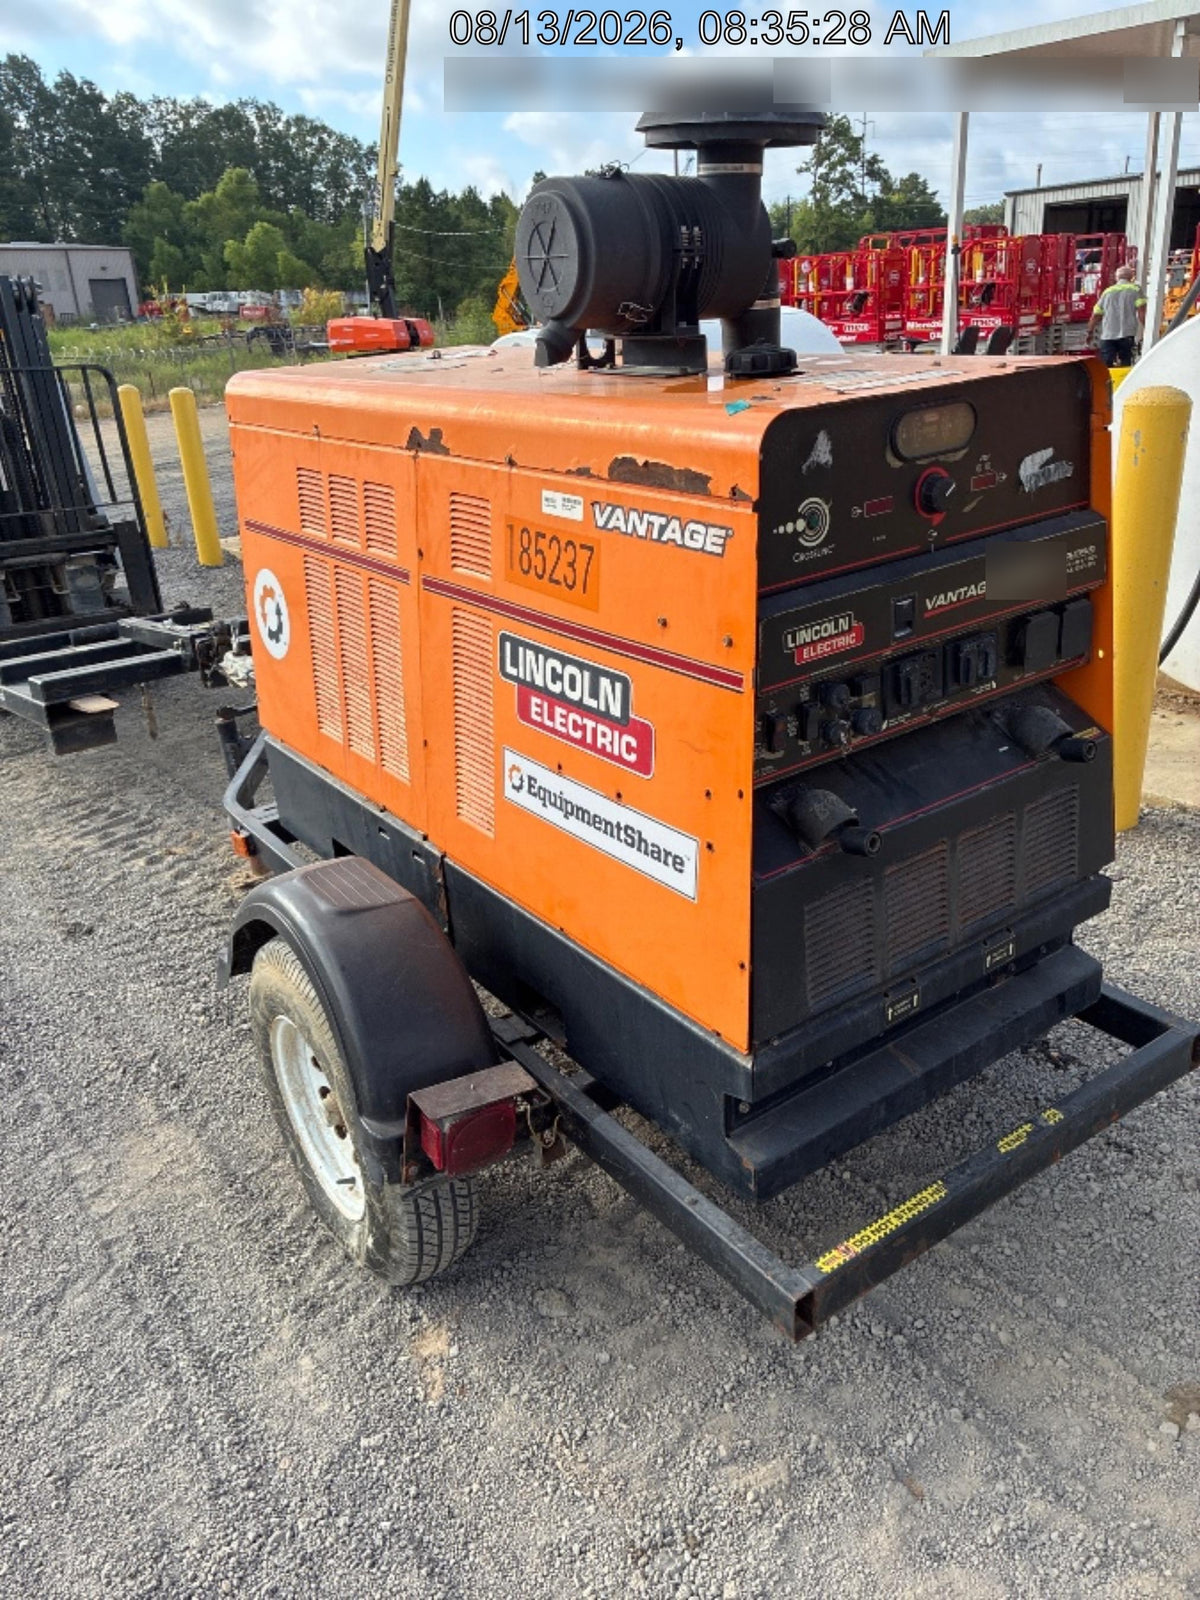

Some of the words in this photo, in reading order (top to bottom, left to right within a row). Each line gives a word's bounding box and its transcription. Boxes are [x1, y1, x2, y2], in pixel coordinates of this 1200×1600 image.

[592, 502, 727, 558] VANTAGE
[507, 522, 595, 595] 185237
[925, 581, 986, 610] VANTAG
[787, 618, 849, 648] LINCOLN
[802, 633, 857, 659] ELECTRIC
[504, 640, 623, 717] LINCOLN
[530, 696, 638, 763] ELECTRIC
[526, 775, 687, 875] EquipmentShare
[852, 1235, 872, 1248] DO
[871, 1219, 895, 1237] NOT
[893, 1196, 929, 1220] STAND
